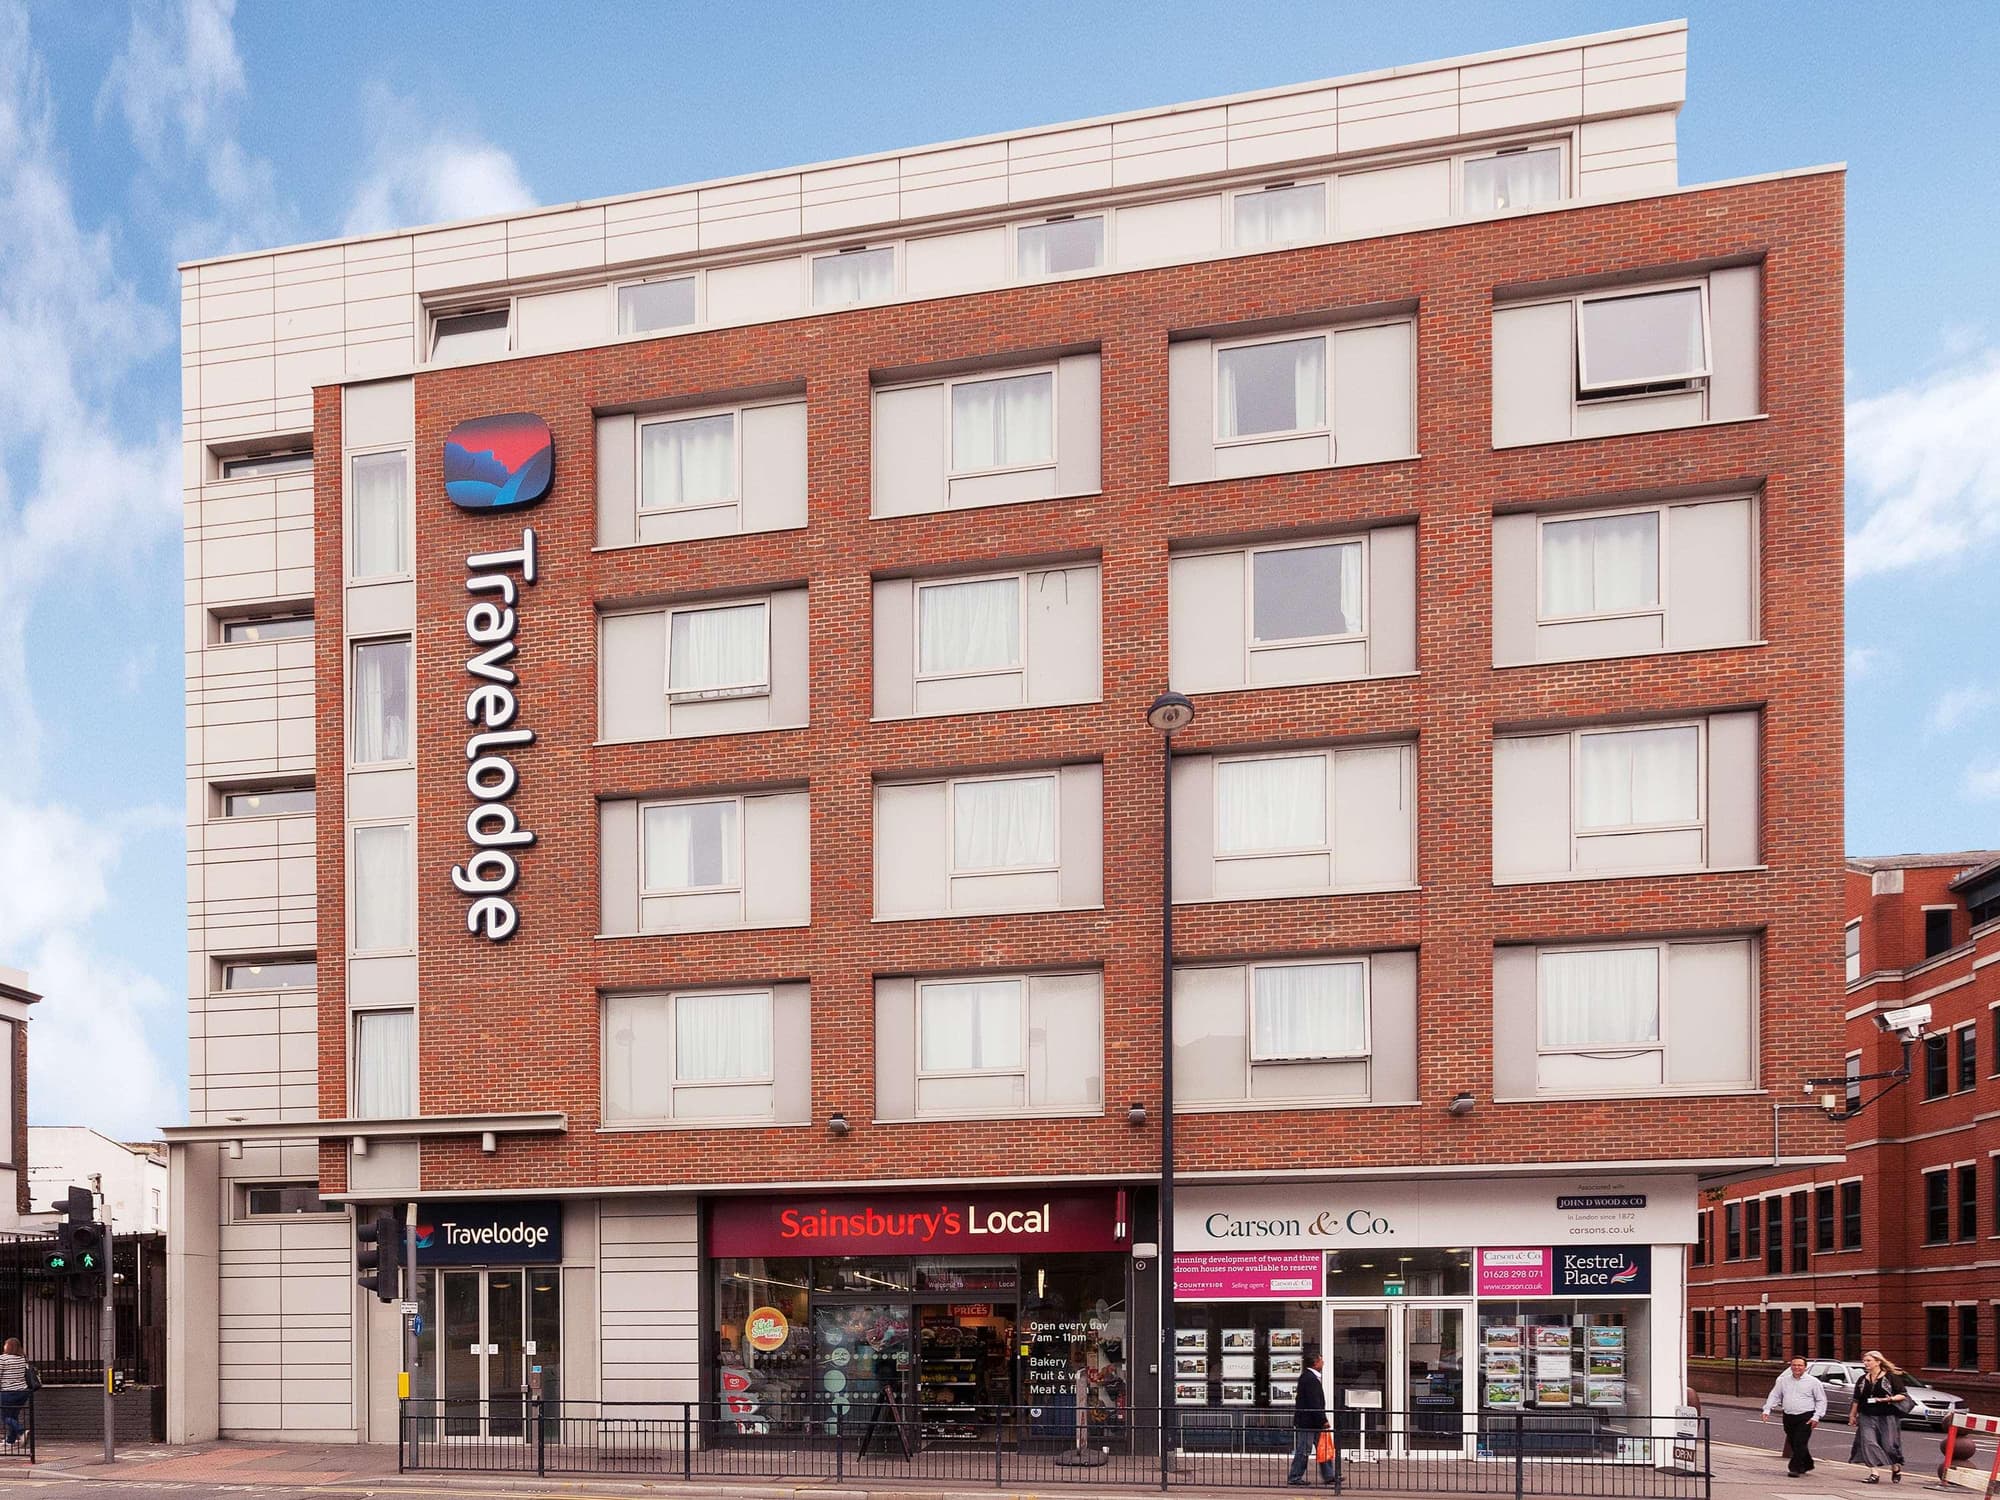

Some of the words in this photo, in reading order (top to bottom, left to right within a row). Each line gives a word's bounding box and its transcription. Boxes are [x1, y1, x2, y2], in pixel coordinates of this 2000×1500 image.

[450, 528, 537, 941] Travelodge
[1560, 1199, 1584, 1208] JOHN
[1594, 1198, 1621, 1206] WOOD
[1630, 1198, 1643, 1206] CO
[780, 1206, 961, 1242] Sainsbury's
[968, 1203, 1050, 1235] Local
[1205, 1212, 1300, 1238] Carson
[1308, 1211, 1343, 1236] &
[1346, 1209, 1395, 1236] Co.
[441, 1221, 550, 1248] Travelodge
[1569, 1225, 1635, 1235] carsons.co.uk
[1173, 1256, 1207, 1265] stunning
[1208, 1255, 1257, 1264] development
[1258, 1254, 1266, 1262] of
[1299, 1254, 1320, 1262] three
[1564, 1254, 1624, 1269] Kestrel
[1200, 1264, 1226, 1273] houses
[1244, 1264, 1280, 1272] available
[1483, 1270, 1509, 1279] 01628
[1511, 1270, 1527, 1278] 298
[1564, 1270, 1608, 1285] Place
[954, 1307, 988, 1315] PRICES
[1030, 1321, 1056, 1331] Open
[1058, 1322, 1087, 1331] every
[1089, 1321, 1108, 1331] day
[1030, 1333, 1053, 1342] 7am
[1062, 1333, 1087, 1343] 11pm
[1030, 1357, 1067, 1368] Bakery
[1030, 1370, 1054, 1380] Fruit
[1057, 1370, 1065, 1380] &
[1030, 1384, 1056, 1394] Meat
[1059, 1384, 1067, 1394] &
